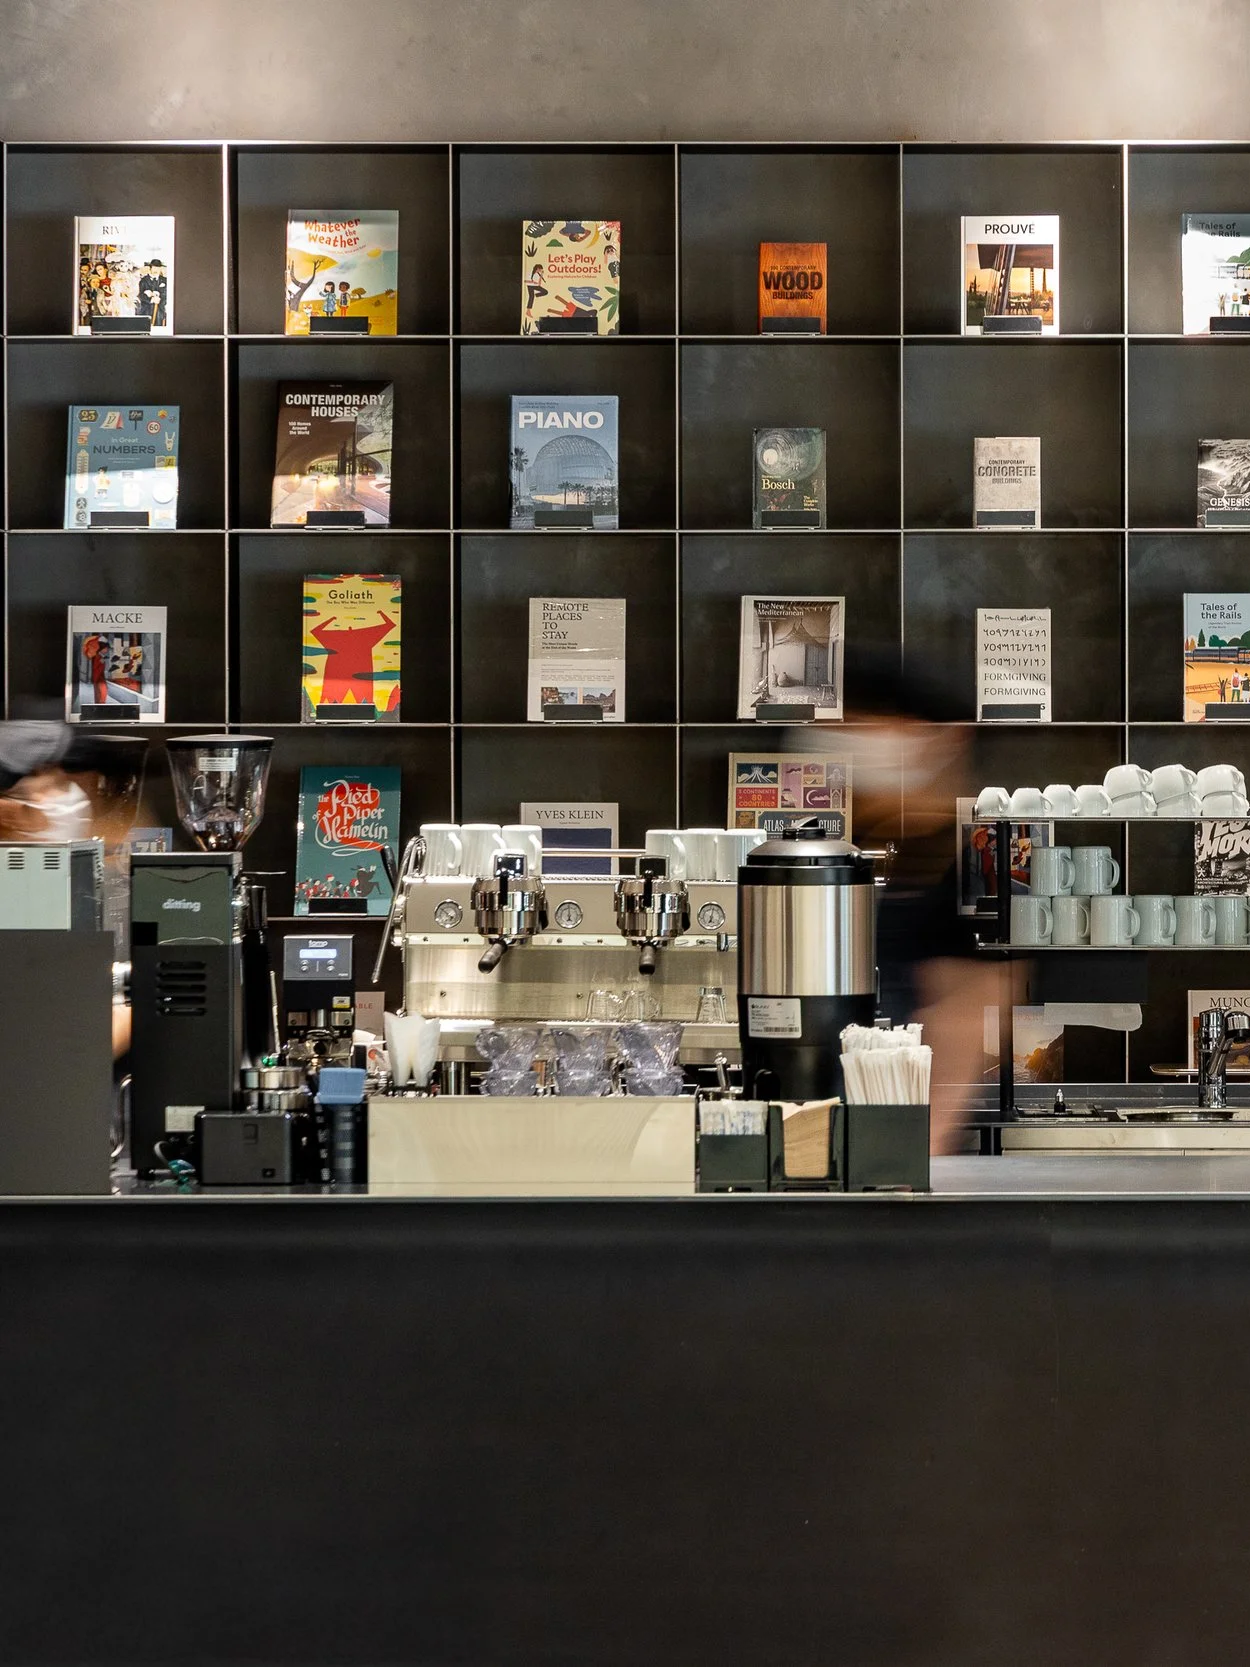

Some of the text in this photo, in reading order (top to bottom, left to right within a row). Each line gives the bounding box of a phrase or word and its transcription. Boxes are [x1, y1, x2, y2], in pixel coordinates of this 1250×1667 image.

[304, 219, 361, 233] Whatever
[1199, 222, 1237, 230] Tales of
[345, 229, 357, 237] the
[308, 233, 360, 248] Weather
[548, 254, 597, 264] Let's Play
[548, 264, 602, 273] Outdoors!
[763, 272, 823, 290] WOOD
[773, 292, 814, 300] BUILDINGS
[285, 394, 386, 406] CONTEMPORARY
[311, 406, 359, 417] HOUSES
[518, 412, 604, 429] PIANO
[93, 446, 156, 454] NUMBERS
[977, 466, 1037, 477] CONCRETE
[761, 479, 796, 490] Bosch
[1209, 498, 1250, 507] GENESIS
[328, 590, 373, 600] Goliath
[542, 603, 589, 611] REMOTE
[1201, 603, 1225, 611] Tales
[92, 613, 143, 623] MACKE
[542, 612, 583, 620] PLACES
[542, 621, 558, 629] TO
[542, 631, 569, 639] STAY
[984, 673, 1046, 681] FORMGIVING
[984, 688, 1046, 696] FORMGIVING
[323, 779, 381, 818] Pied
[341, 802, 386, 826] Piper
[536, 810, 604, 819] YVES KLEIN
[763, 820, 784, 831] ATLAS
[315, 816, 388, 848] Hamelin
